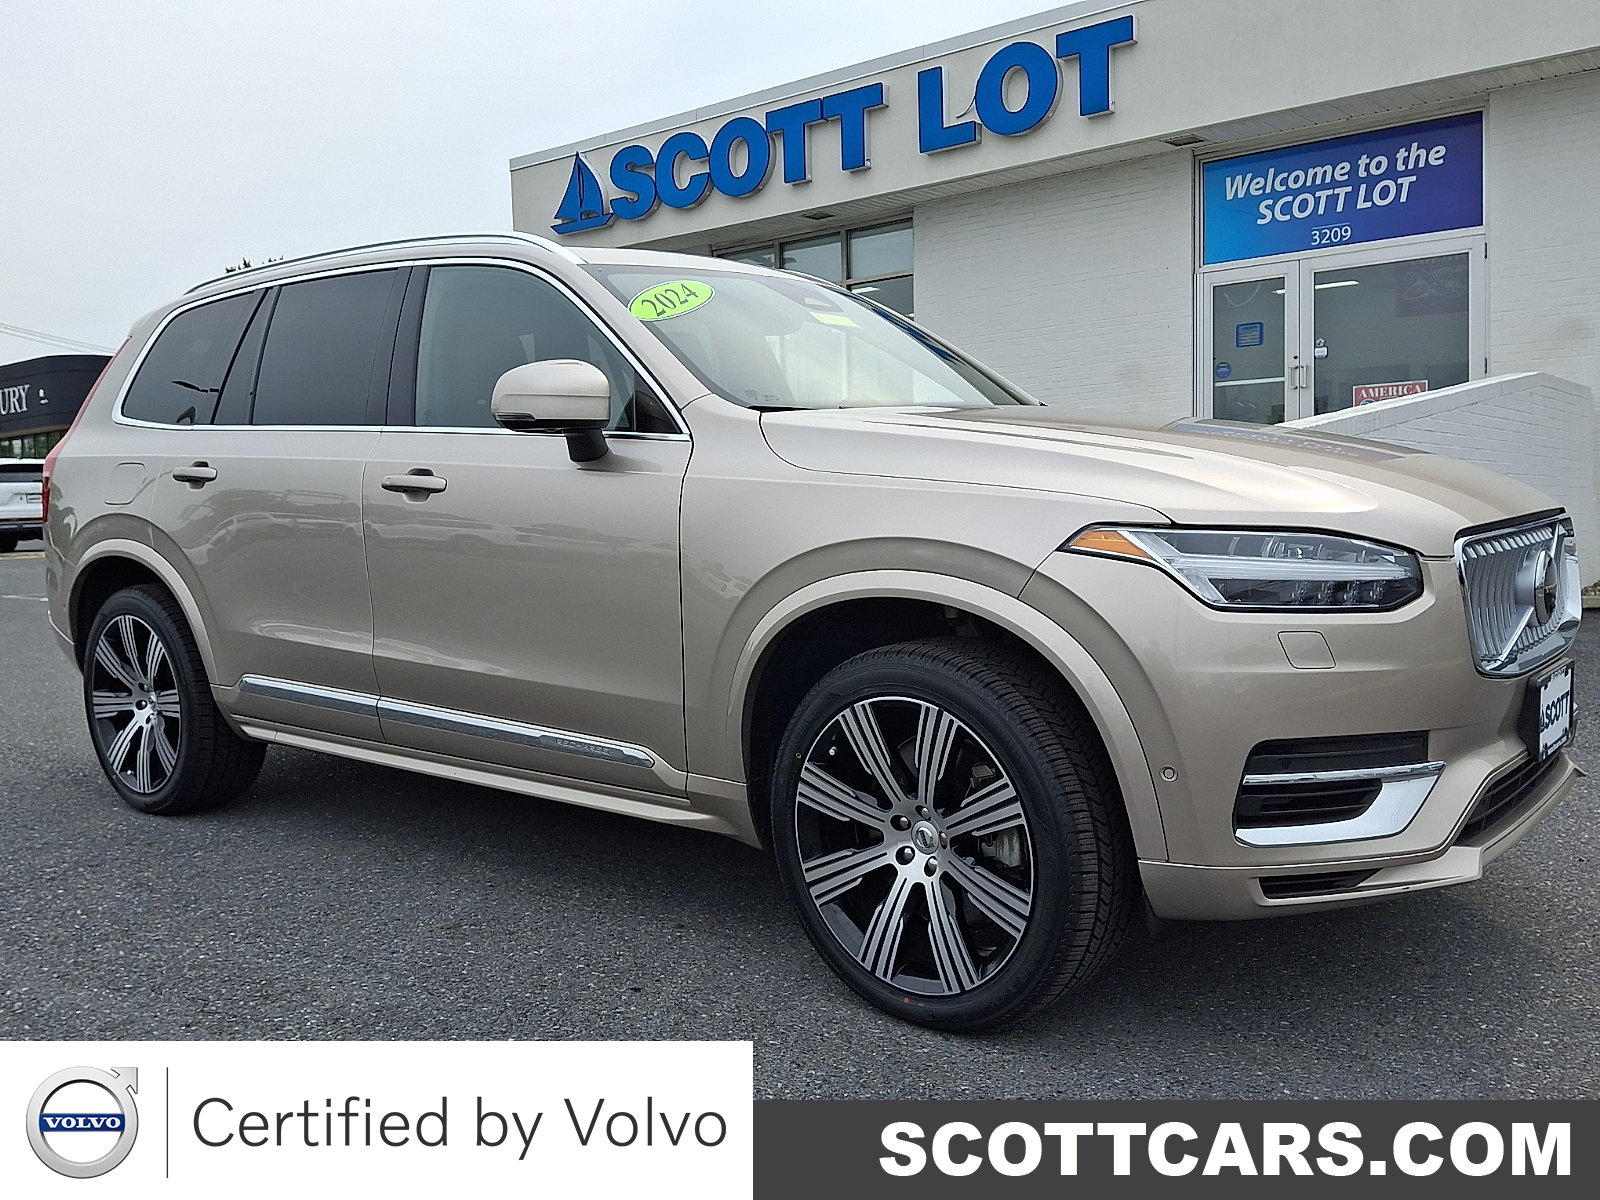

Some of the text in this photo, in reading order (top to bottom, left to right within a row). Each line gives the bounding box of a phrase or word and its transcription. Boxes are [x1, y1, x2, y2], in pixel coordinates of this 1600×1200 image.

[609, 15, 1136, 220] SCOTT LOT
[1224, 142, 1446, 201] Welcome to the
[1256, 176, 1417, 225] SCOTT LOT
[1311, 225, 1352, 246] 3209
[641, 283, 699, 317] 2024
[1359, 384, 1422, 399] AMERICA
[1545, 690, 1569, 729] SCOTT
